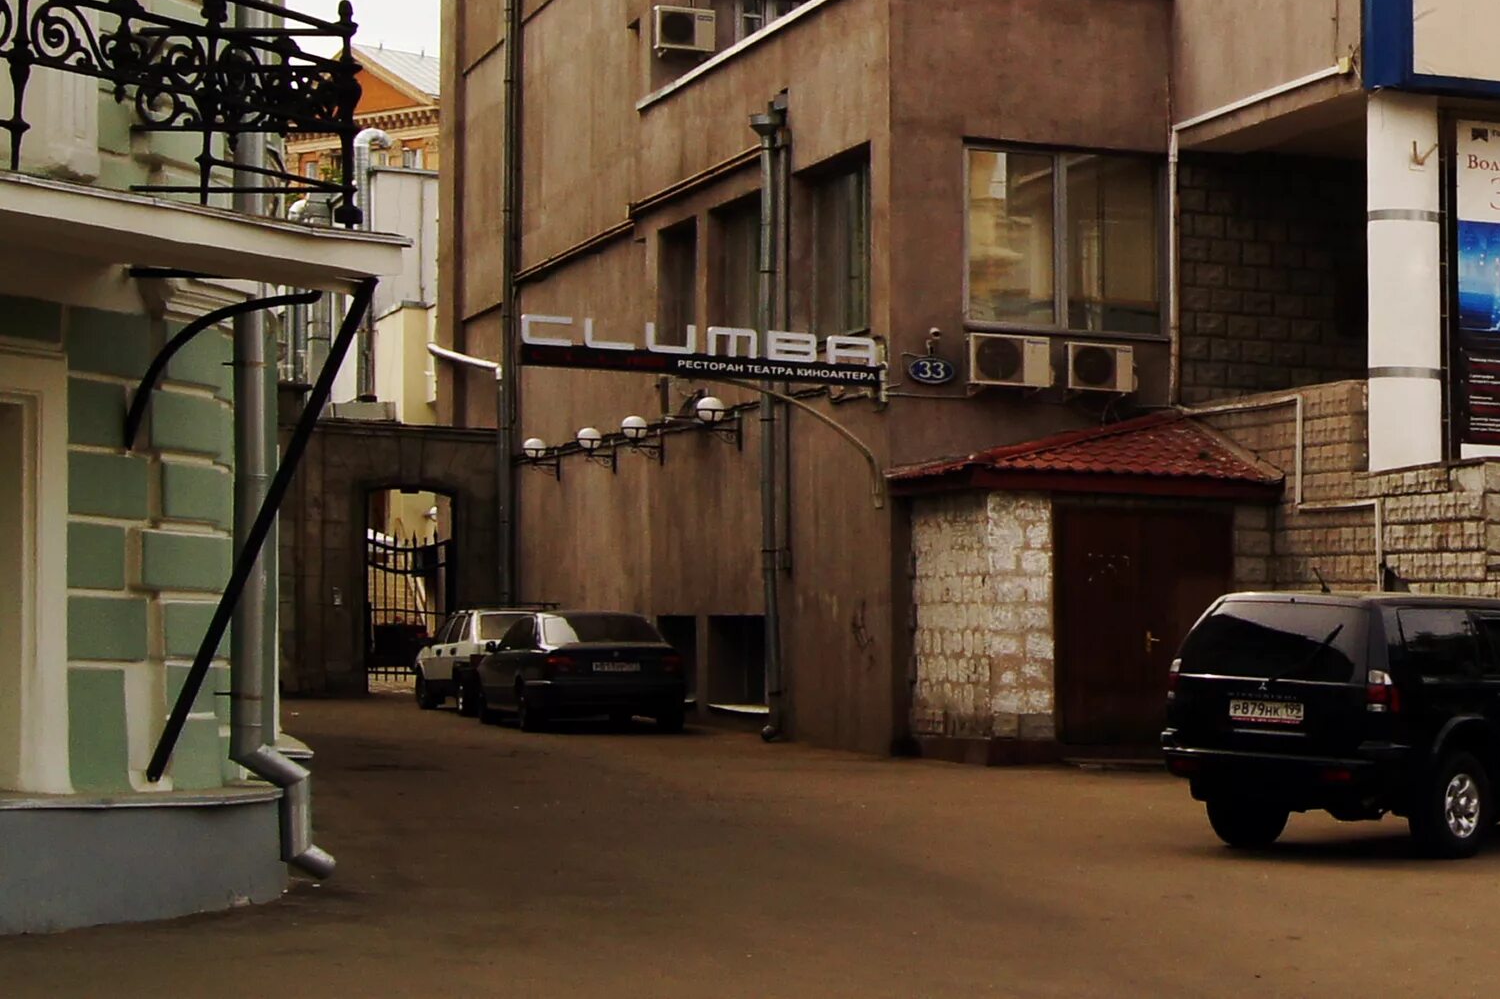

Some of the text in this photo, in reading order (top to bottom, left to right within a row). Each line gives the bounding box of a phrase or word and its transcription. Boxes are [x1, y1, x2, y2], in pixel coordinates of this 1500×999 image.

[521, 313, 878, 366] CLUMBA
[677, 359, 744, 373] РЕСТОРАН
[746, 364, 794, 377] ТЕАТРА
[796, 367, 876, 382] КИНОАКТЕРА
[919, 361, 945, 379] 33
